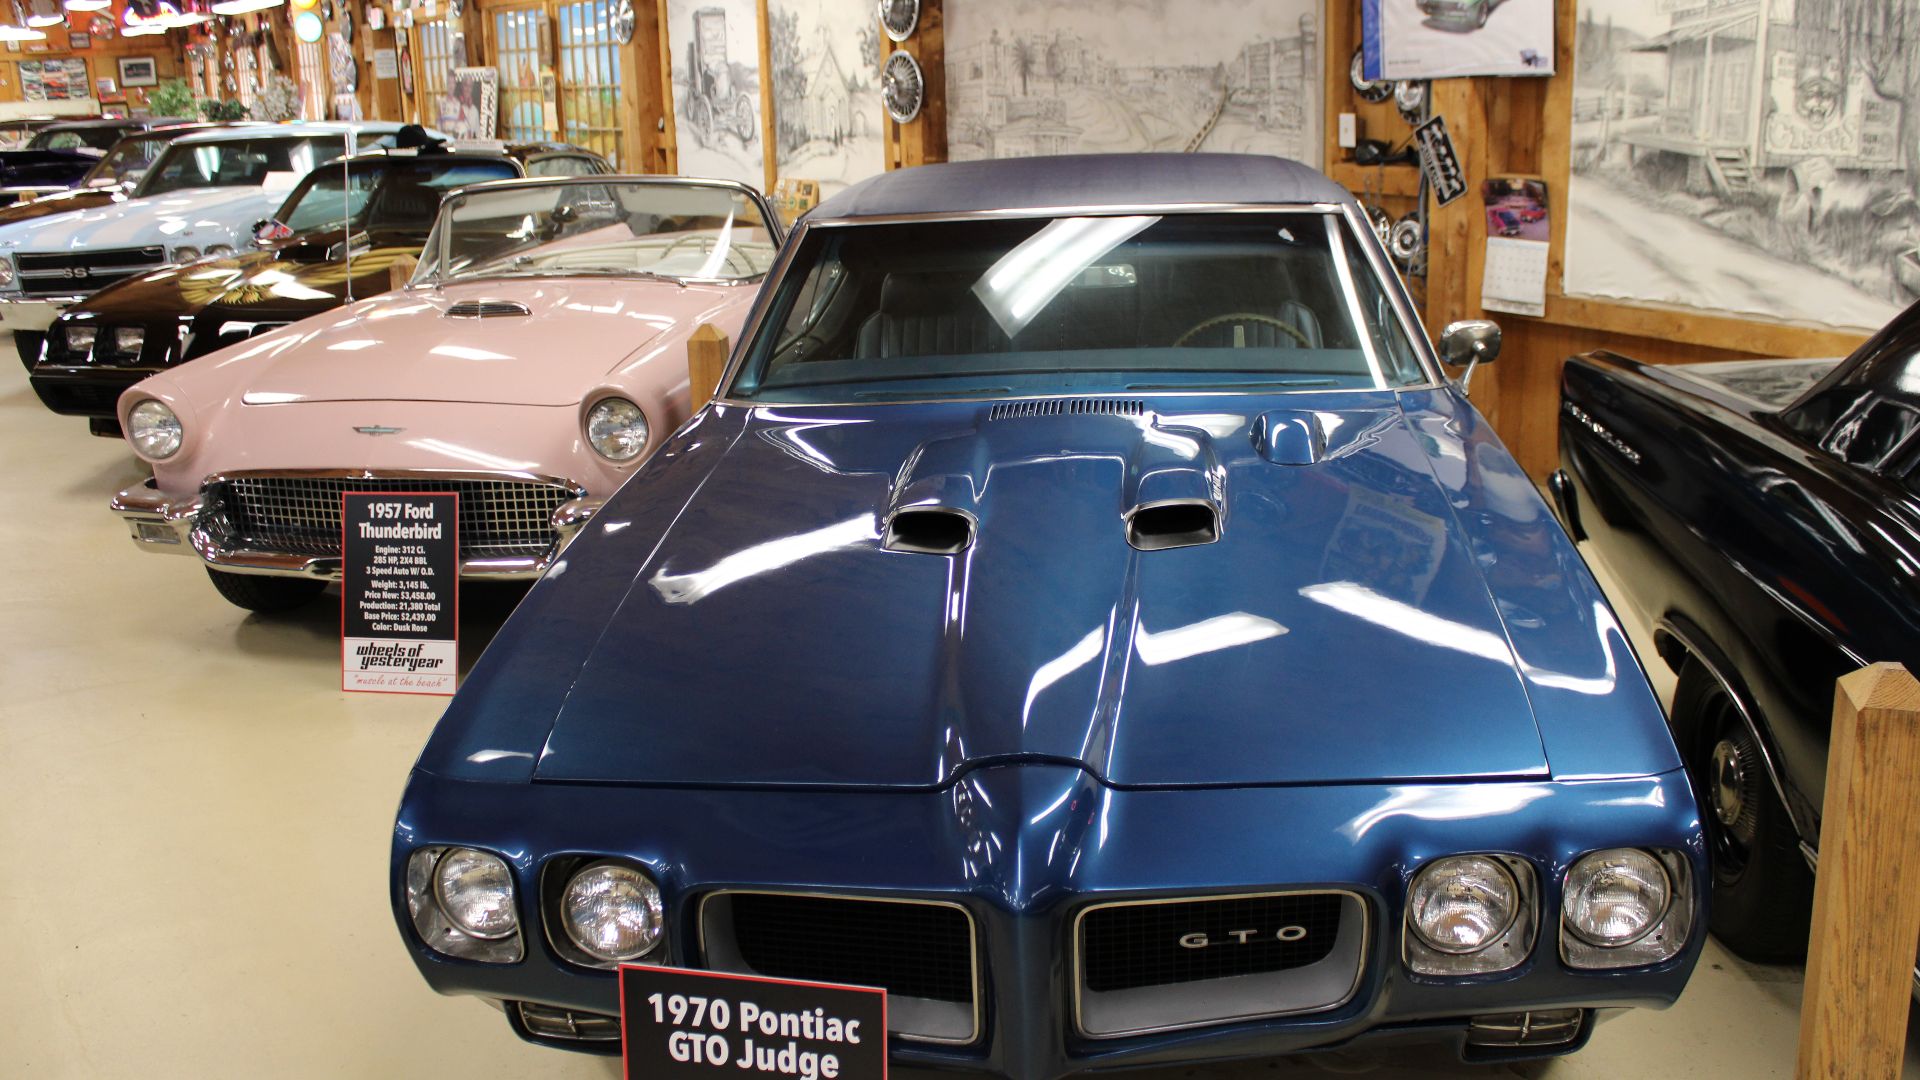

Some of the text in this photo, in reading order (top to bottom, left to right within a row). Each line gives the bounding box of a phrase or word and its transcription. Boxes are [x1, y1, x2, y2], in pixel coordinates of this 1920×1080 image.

[63, 267, 87, 279] SS
[367, 502, 434, 519] 1957 Ford
[358, 521, 442, 540] Thunderbird
[375, 545, 401, 555] Engine:
[402, 546, 416, 554] 312
[373, 556, 428, 566] 285 HP, 2X4 BBL
[366, 566, 371, 575] 3
[371, 566, 393, 576] Speed
[393, 567, 410, 576] Auto
[410, 567, 420, 576] W/
[371, 580, 398, 590] Weight:
[398, 580, 419, 590] 3,145
[364, 590, 436, 601] Price New: $3,458.00
[359, 600, 441, 612] Production: 21,380 Total
[364, 611, 437, 622] Base Price: $2,439.00
[372, 622, 428, 632] Color: Dusk Rose
[356, 642, 425, 658] wheels of
[360, 653, 444, 672] yesteryear
[387, 678, 398, 686] at
[399, 676, 414, 687] the
[1179, 925, 1307, 949] GTO
[648, 993, 861, 1044] 1970 Pontiac
[668, 1031, 840, 1080] GTO Judge
